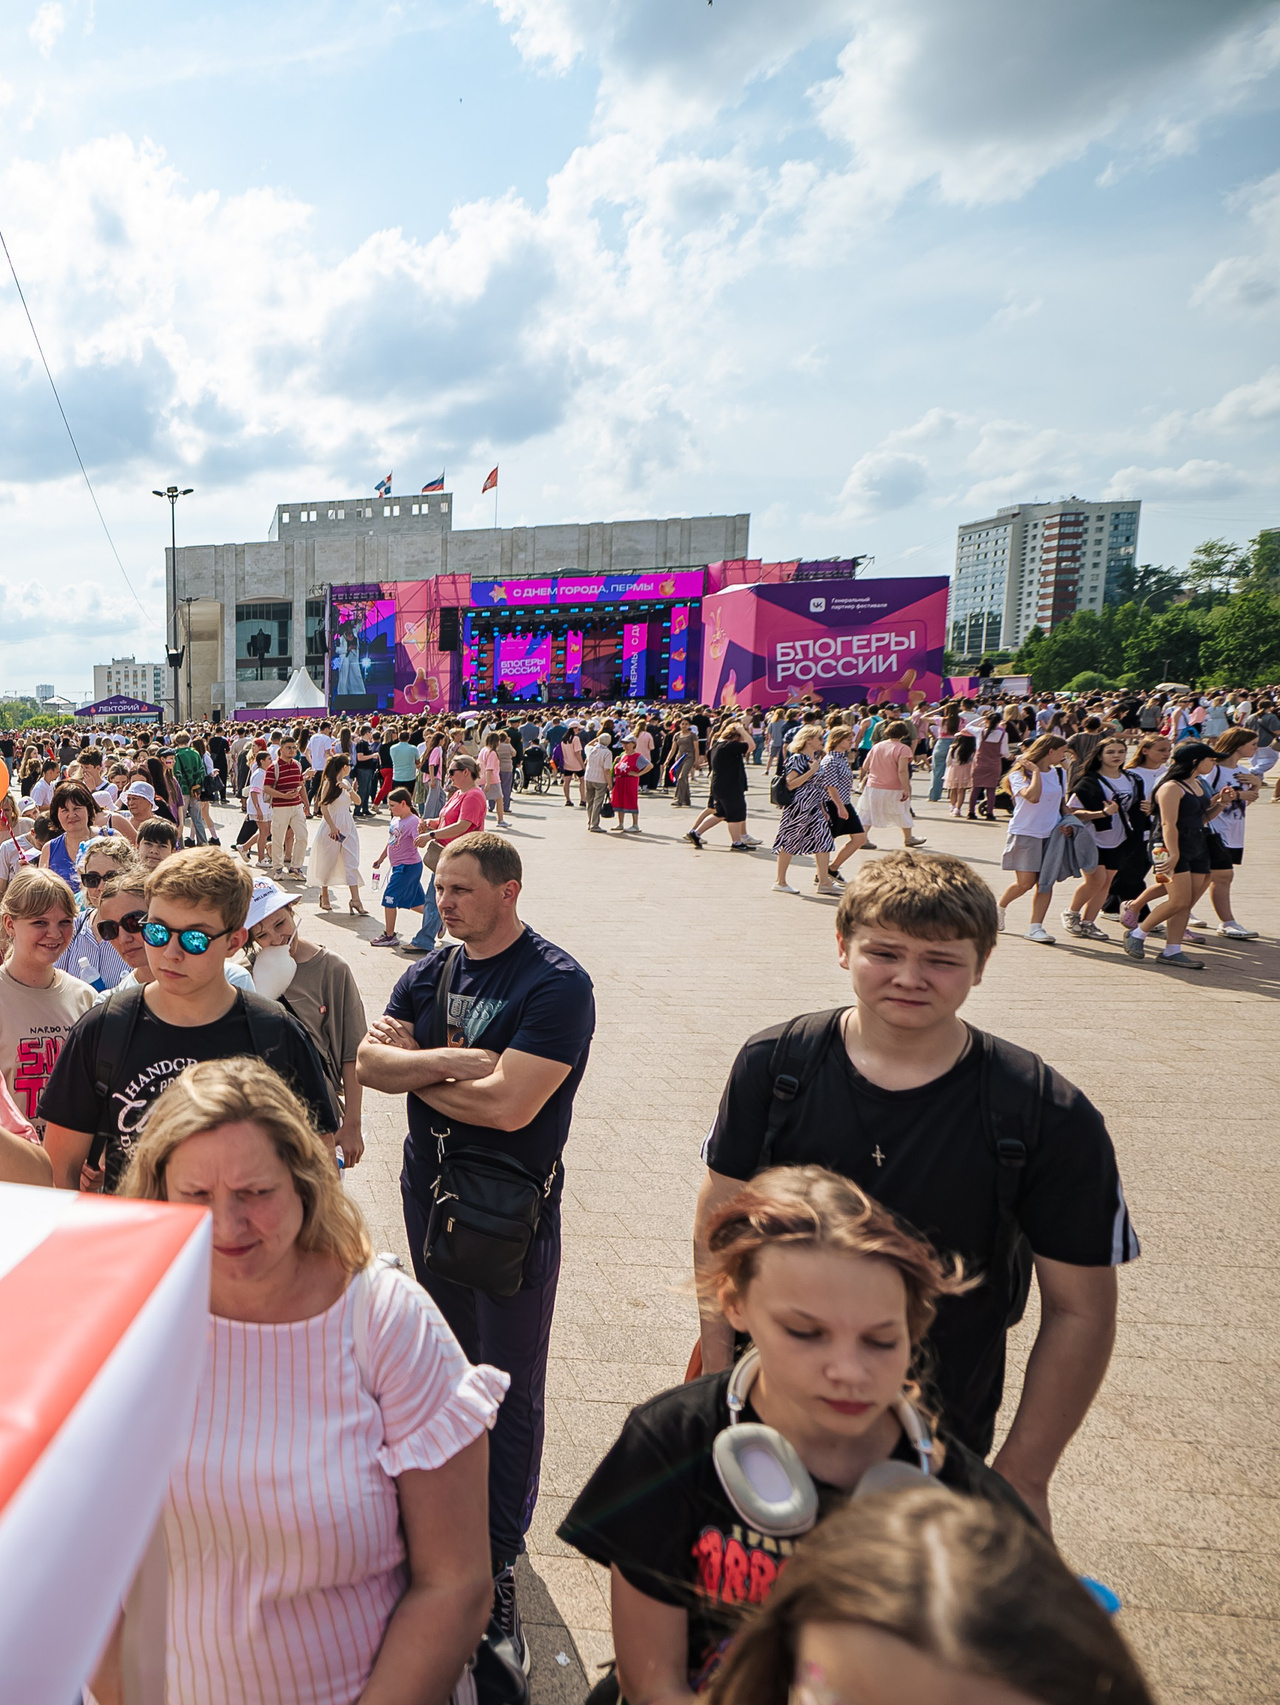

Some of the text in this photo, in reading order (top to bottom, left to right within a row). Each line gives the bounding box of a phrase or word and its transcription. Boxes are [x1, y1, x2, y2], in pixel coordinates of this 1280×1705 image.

[513, 588, 522, 597] С
[523, 586, 558, 598] ДНЕМ
[559, 583, 609, 595] ГОРОДА,
[776, 630, 916, 662] БЛОГЕРЫ
[501, 658, 546, 668] БЛОГЕРЫ
[776, 653, 898, 682] РОССИИ
[501, 666, 541, 675] РОССИИ
[98, 704, 139, 712] ЛЕКТОРИЙ
[30, 1025, 61, 1034] NARDO
